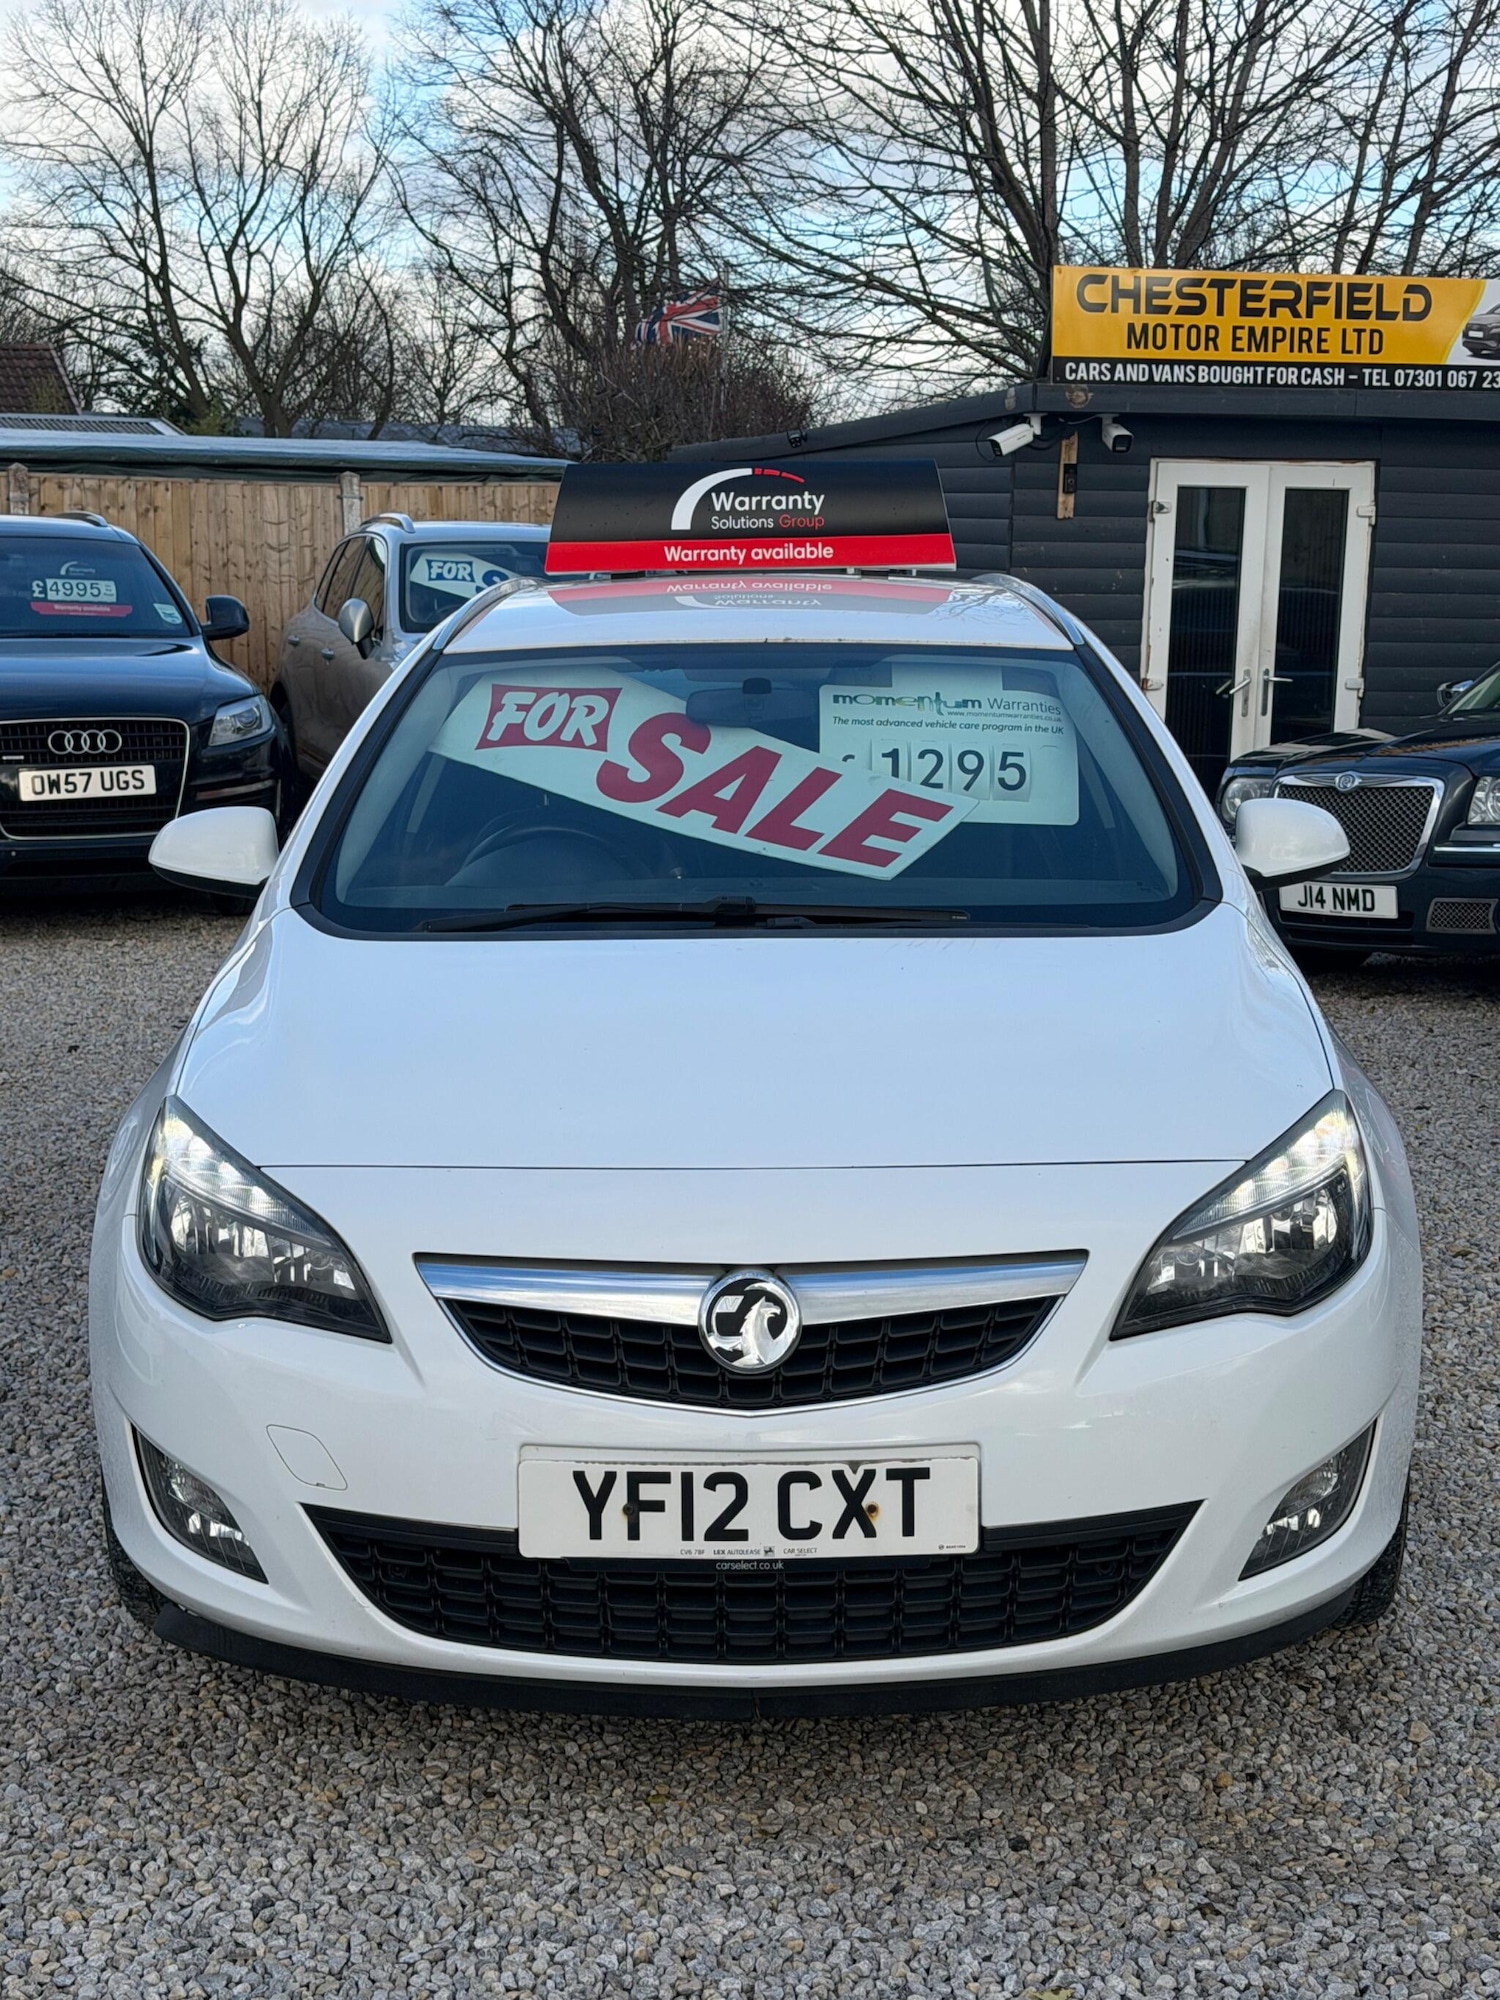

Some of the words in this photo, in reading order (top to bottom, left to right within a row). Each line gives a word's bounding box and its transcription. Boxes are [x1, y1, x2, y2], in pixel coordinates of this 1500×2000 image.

[1076, 273, 1433, 322] CHESTERFIELD
[1126, 322, 1220, 352] MOTOR
[1231, 325, 1331, 355] EMPIRE
[1341, 327, 1384, 355] LTD
[1065, 362, 1112, 381] CARS
[1113, 363, 1150, 382] AND
[1151, 364, 1196, 383] VANS
[1197, 365, 1265, 384] BOUGHT
[1266, 367, 1299, 385] FOR
[1300, 367, 1345, 386] CASH
[1362, 368, 1391, 387] TEL
[1394, 369, 1443, 388] 07301
[1447, 370, 1478, 388] 067
[710, 491, 826, 516] Warranty
[710, 515, 774, 530] Solutions
[778, 513, 826, 531] Group
[663, 545, 747, 566] Warranty
[751, 541, 834, 561] available
[430, 561, 472, 582] FOR
[832, 691, 983, 716] momentum
[986, 698, 1062, 716] Warranties
[485, 689, 610, 749] FOR
[832, 716, 850, 726] The
[851, 718, 875, 727] most
[875, 718, 924, 729] advanced
[924, 720, 958, 730] vehicle
[959, 722, 980, 731] care
[981, 724, 1023, 734] program
[1024, 723, 1033, 732] in
[1034, 724, 1050, 733] the
[1050, 725, 1065, 735] UK
[99, 769, 146, 792] UGS
[881, 748, 1028, 793] 1295
[595, 712, 956, 869] SALE
[1297, 885, 1327, 910] J14
[1331, 886, 1376, 913] NMD
[572, 1470, 749, 1542] YF12
[777, 1467, 931, 1541] CXT
[713, 1548, 726, 1556] LEX
[726, 1548, 761, 1556] AUTOLEASE
[782, 1547, 796, 1555] CAR
[796, 1547, 818, 1555] SELECT
[715, 1560, 785, 1571] carselect.co.uk
